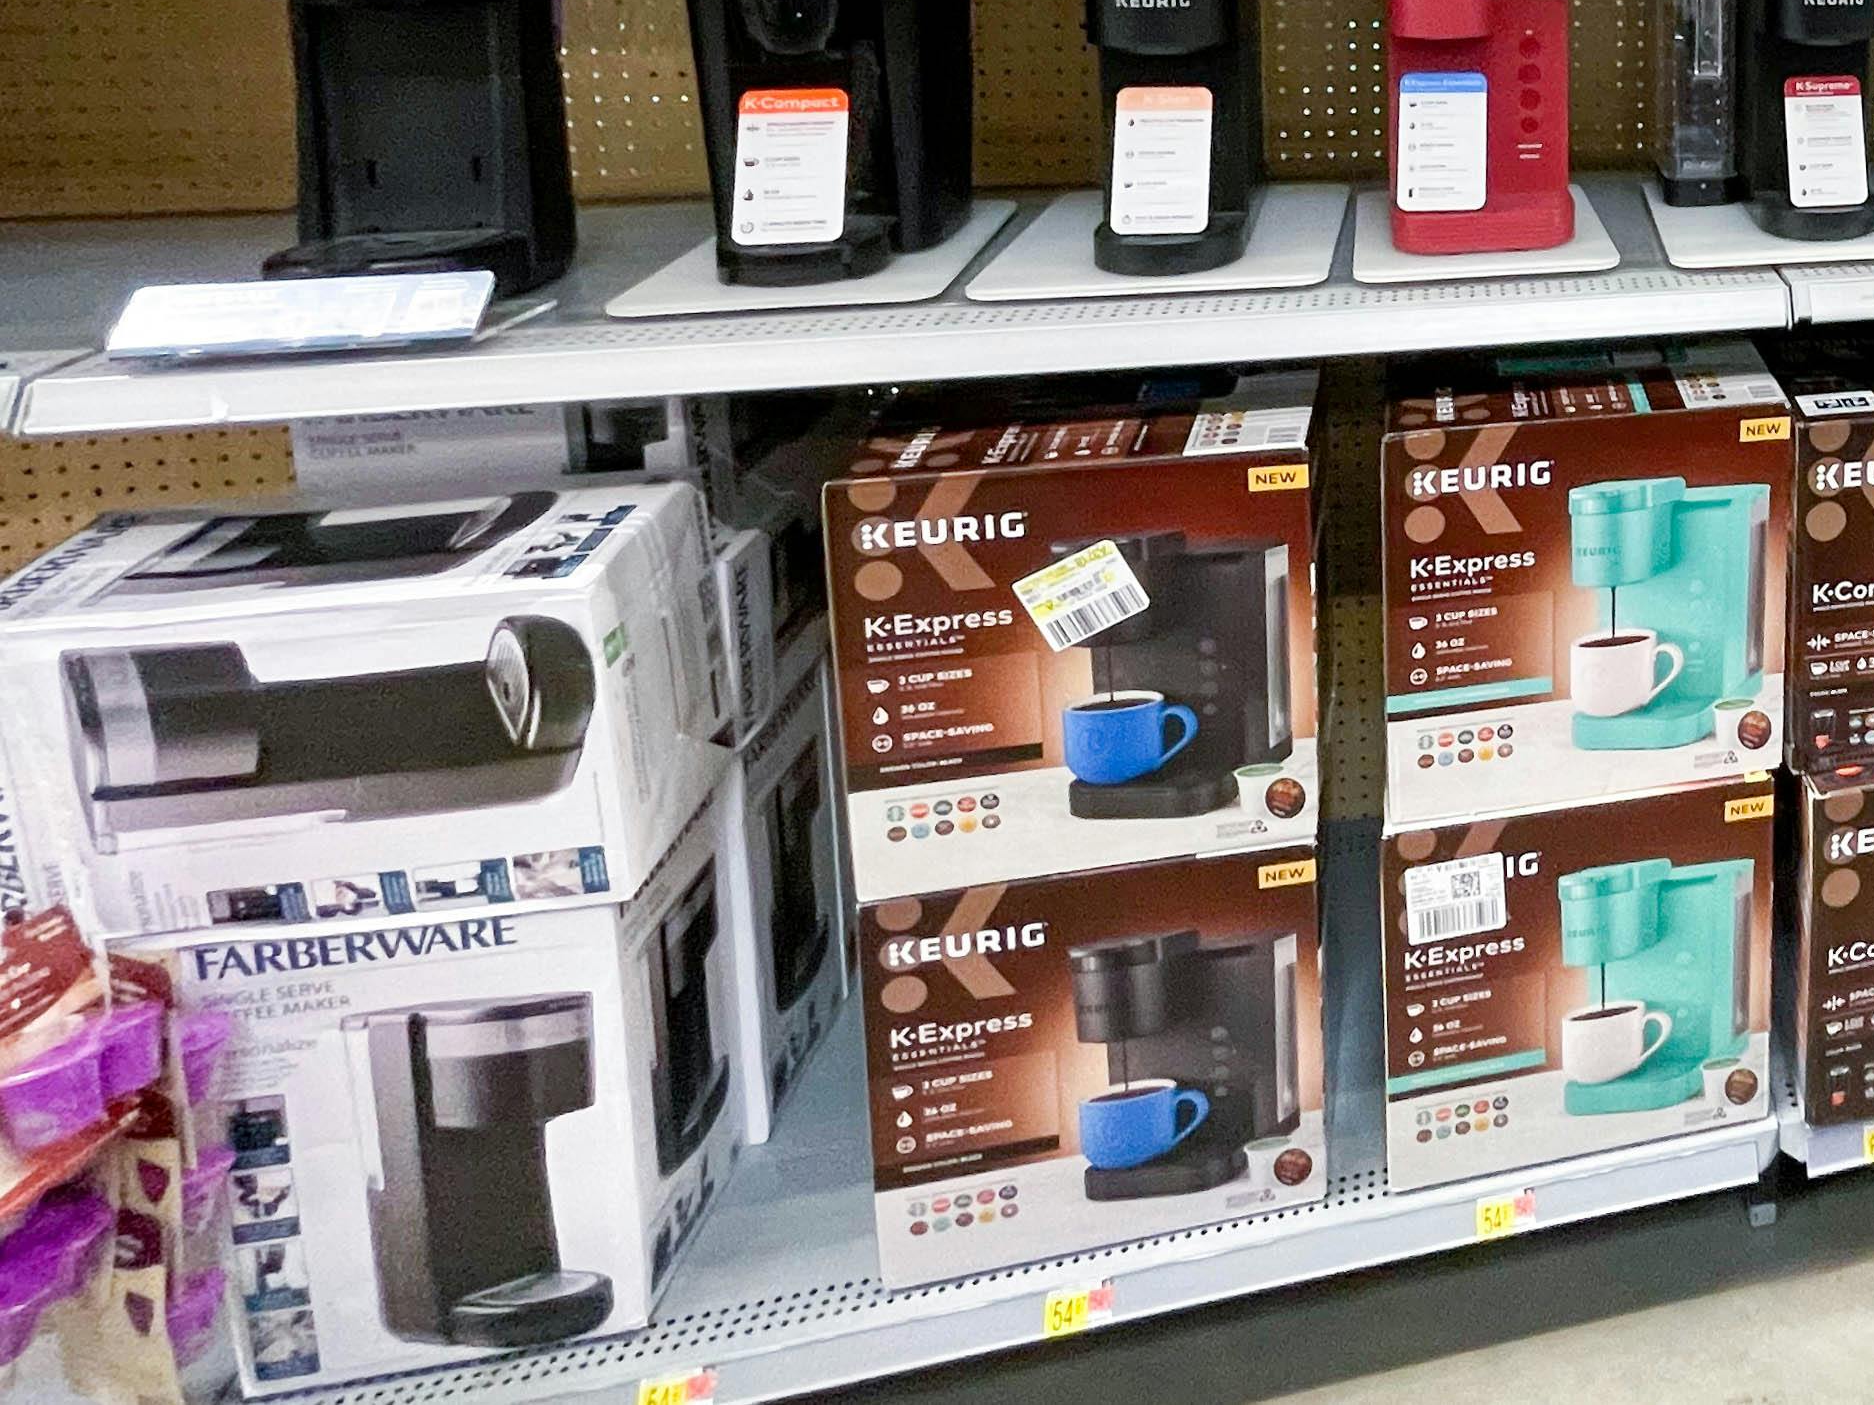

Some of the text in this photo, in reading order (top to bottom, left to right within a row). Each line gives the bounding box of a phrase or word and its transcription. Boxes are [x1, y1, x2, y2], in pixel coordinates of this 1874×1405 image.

[1746, 422, 1781, 437] NEW
[1255, 470, 1298, 487] NEW
[1412, 461, 1553, 496] KEURIG
[861, 511, 1026, 551] KEURIG
[1444, 610, 1466, 622] CUP
[1467, 606, 1498, 618] SIZES
[1450, 637, 1465, 648] OZ
[1436, 658, 1513, 675] SPACE-SAVING
[908, 672, 934, 683] CUP
[918, 701, 936, 712] OZ
[903, 723, 994, 742] SPACE-SAVING
[1730, 800, 1765, 815] NEW
[1264, 866, 1306, 882] NEW
[196, 917, 519, 981] FARBERWARE
[888, 922, 1047, 967] KEURIG
[276, 981, 336, 997] SERVE
[282, 995, 352, 1017] MAKER
[1440, 996, 1461, 1007] CUP
[931, 1076, 957, 1088] CUP
